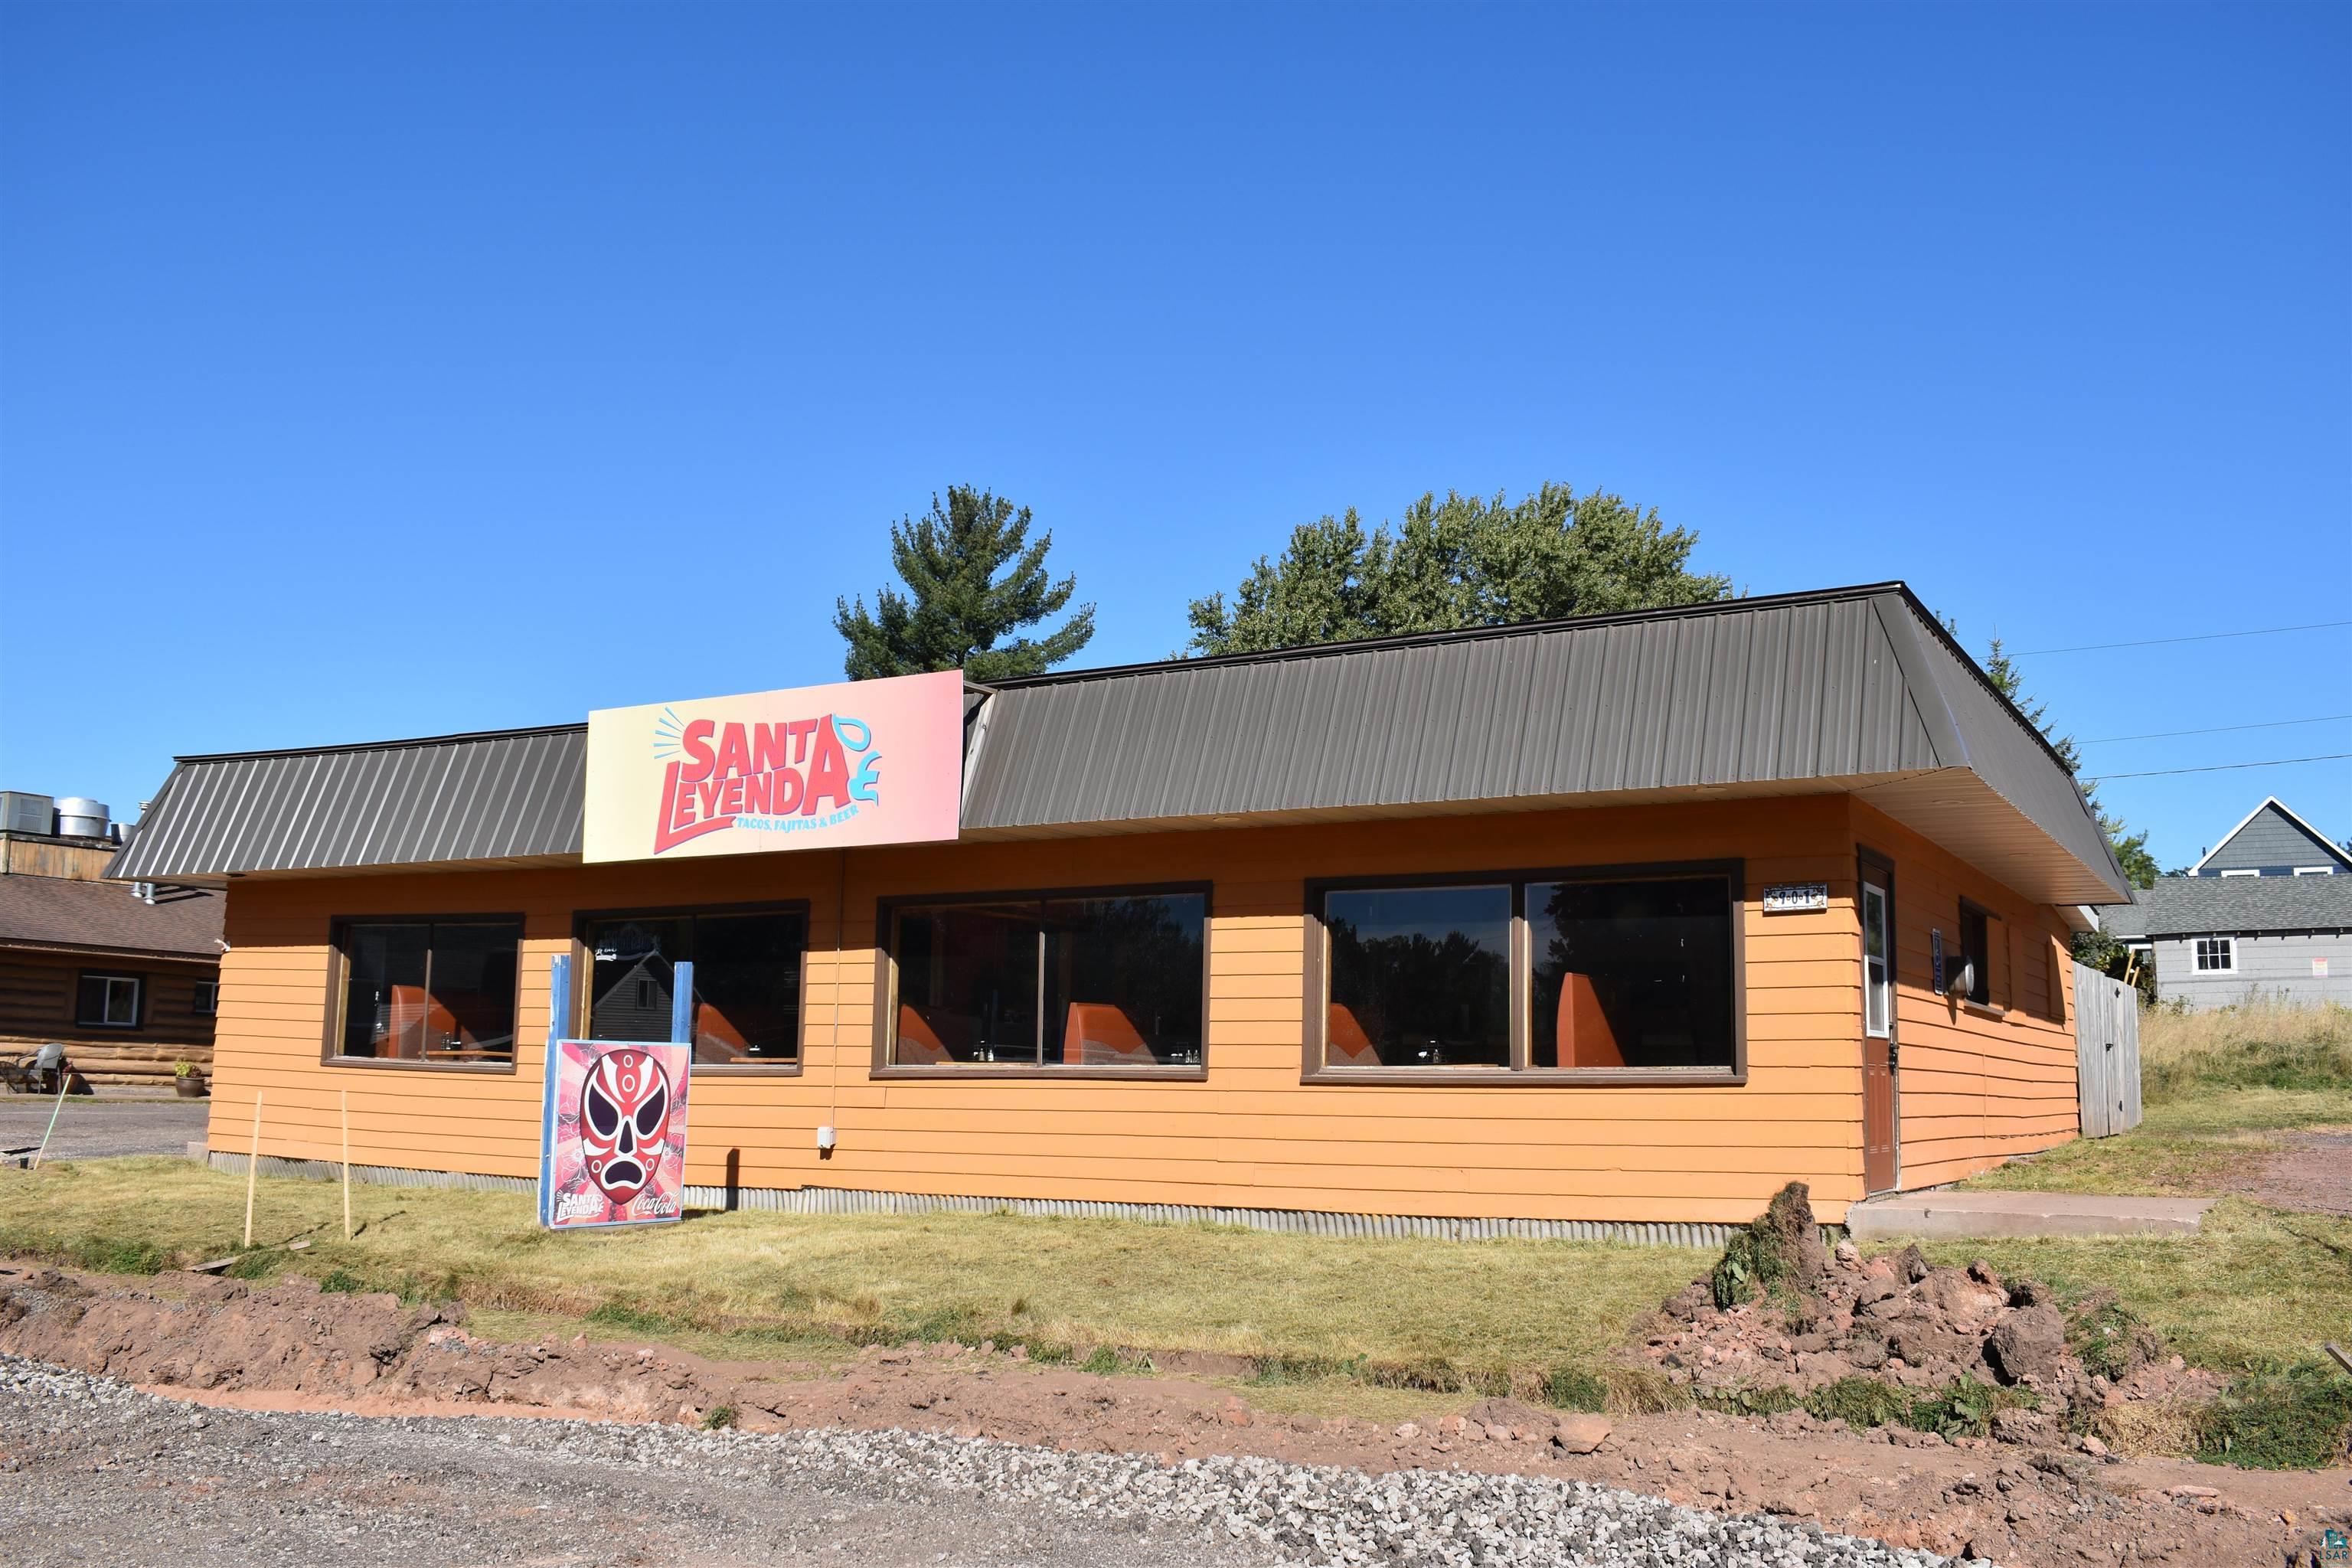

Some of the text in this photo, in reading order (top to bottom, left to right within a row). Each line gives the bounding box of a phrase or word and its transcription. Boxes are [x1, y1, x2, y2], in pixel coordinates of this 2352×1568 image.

[680, 714, 849, 790] SANTA
[654, 758, 851, 854] LEYENDA
[737, 804, 859, 833] TACOS, FAJITAS & BEER
[557, 1201, 599, 1223] LEYENDA
[563, 1192, 598, 1207] SANTA
[632, 1191, 679, 1216] Coca-Cola
